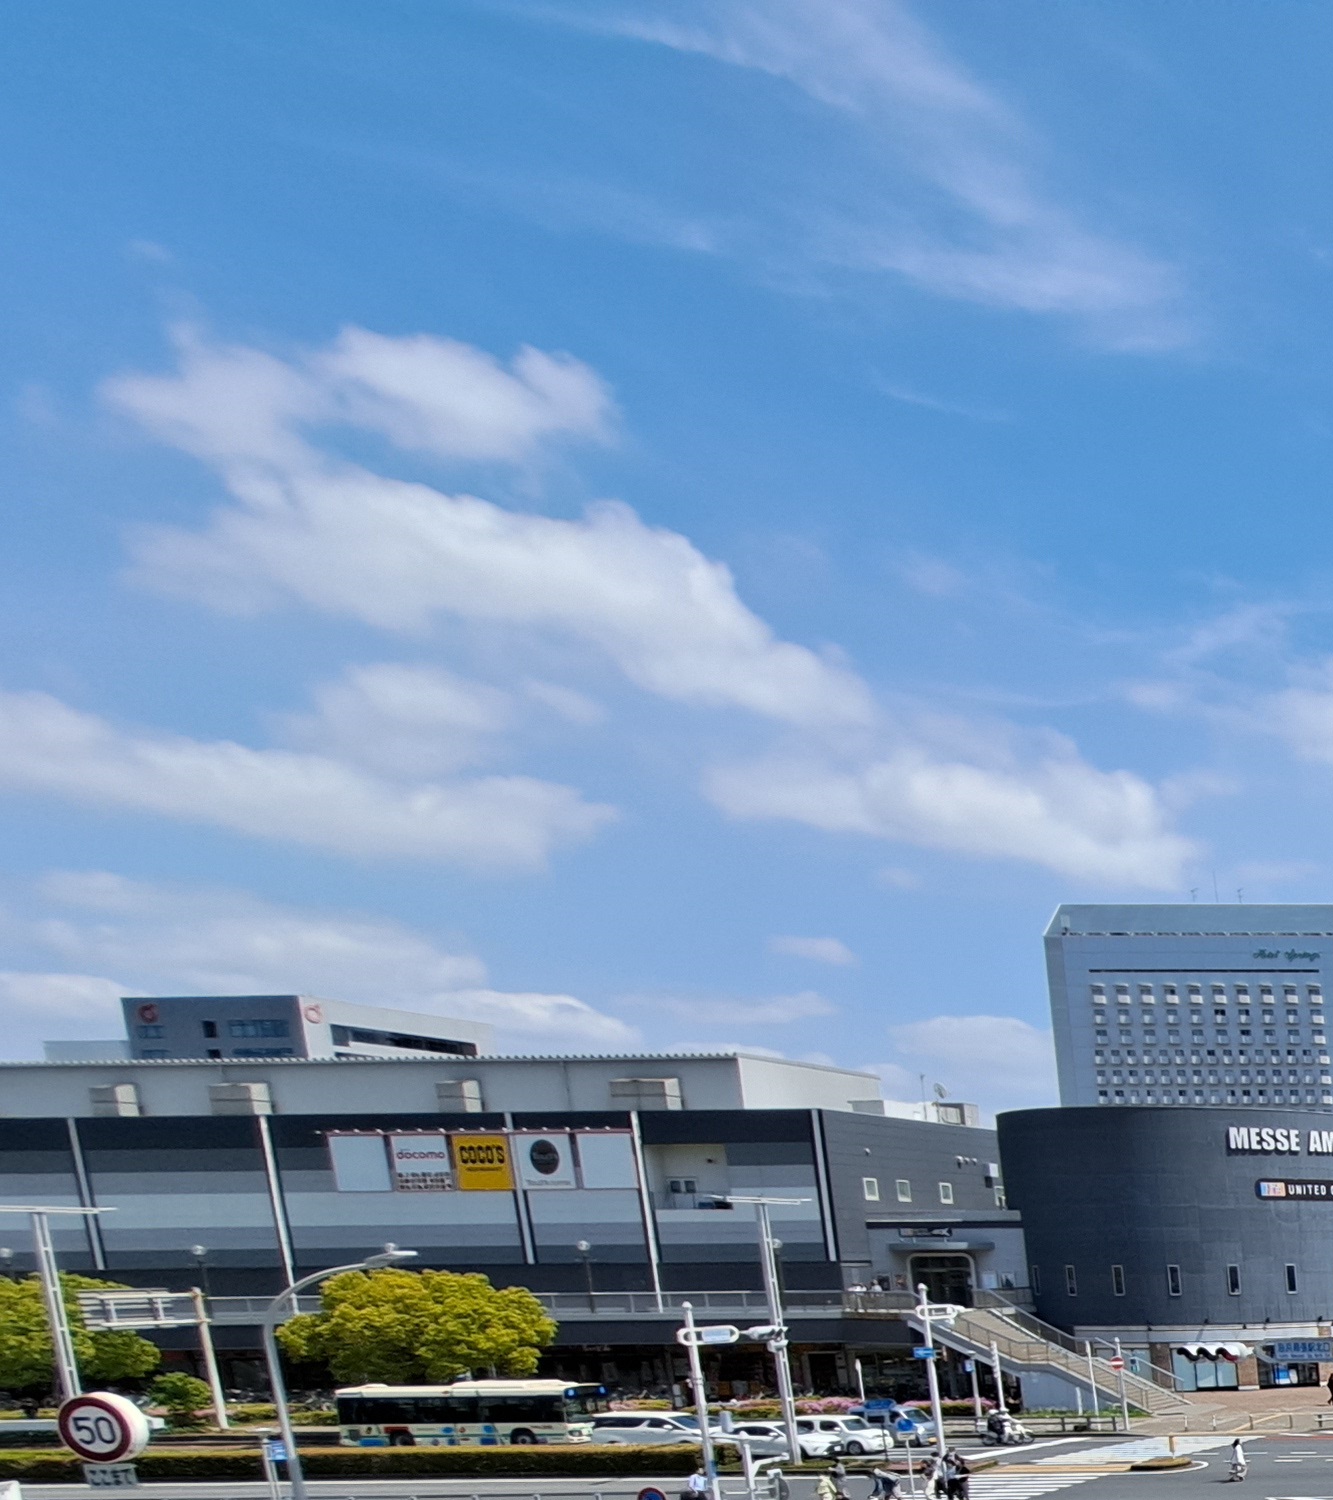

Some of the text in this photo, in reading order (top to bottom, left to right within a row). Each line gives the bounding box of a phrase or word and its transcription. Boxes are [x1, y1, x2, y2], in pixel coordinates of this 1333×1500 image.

[1228, 1126, 1301, 1151] MESSE
[397, 1149, 446, 1160] docomo
[459, 1144, 505, 1164] COCO'S
[1287, 1184, 1327, 1196] UNITED
[72, 1416, 117, 1445] 50
[88, 1469, 134, 1486] ここまで
